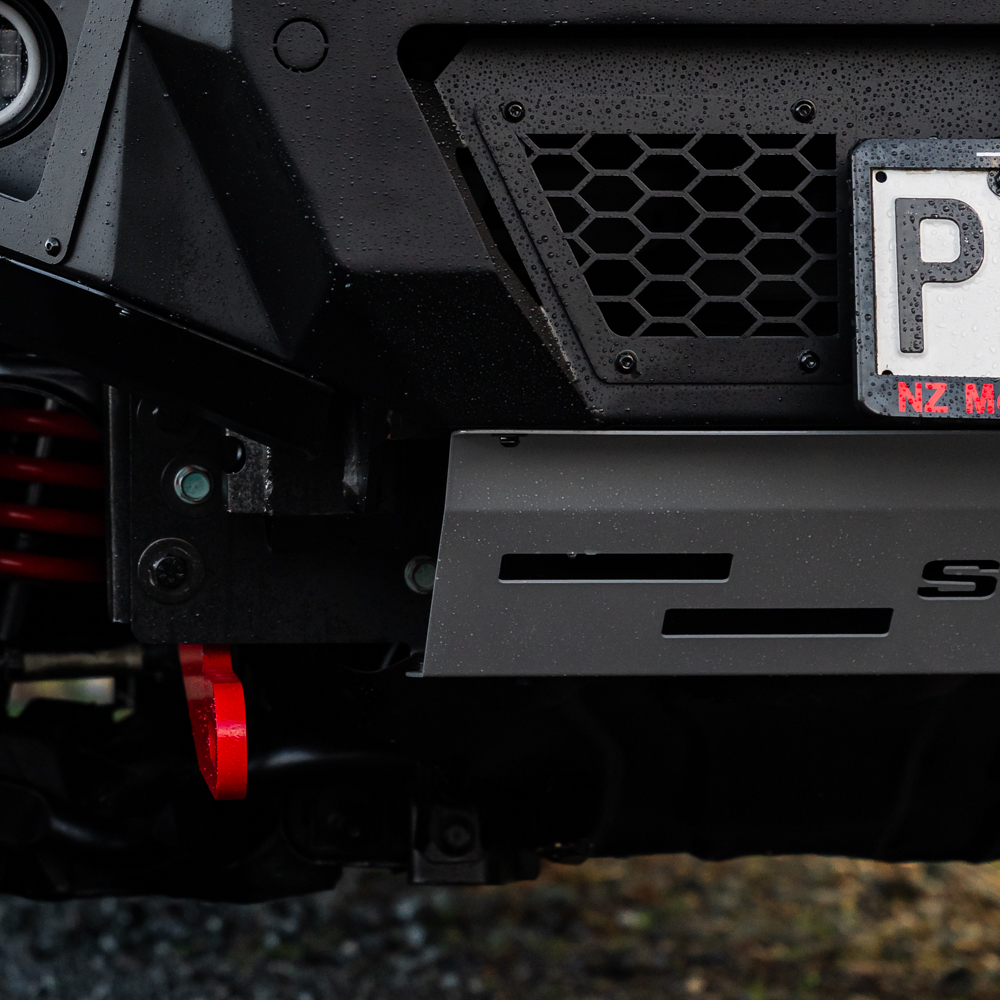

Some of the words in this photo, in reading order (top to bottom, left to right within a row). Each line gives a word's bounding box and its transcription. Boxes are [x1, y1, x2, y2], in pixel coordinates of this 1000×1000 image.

[895, 198, 984, 353] P
[898, 381, 949, 413] NZ
[965, 383, 1000, 414] M
[917, 559, 1000, 599] S
